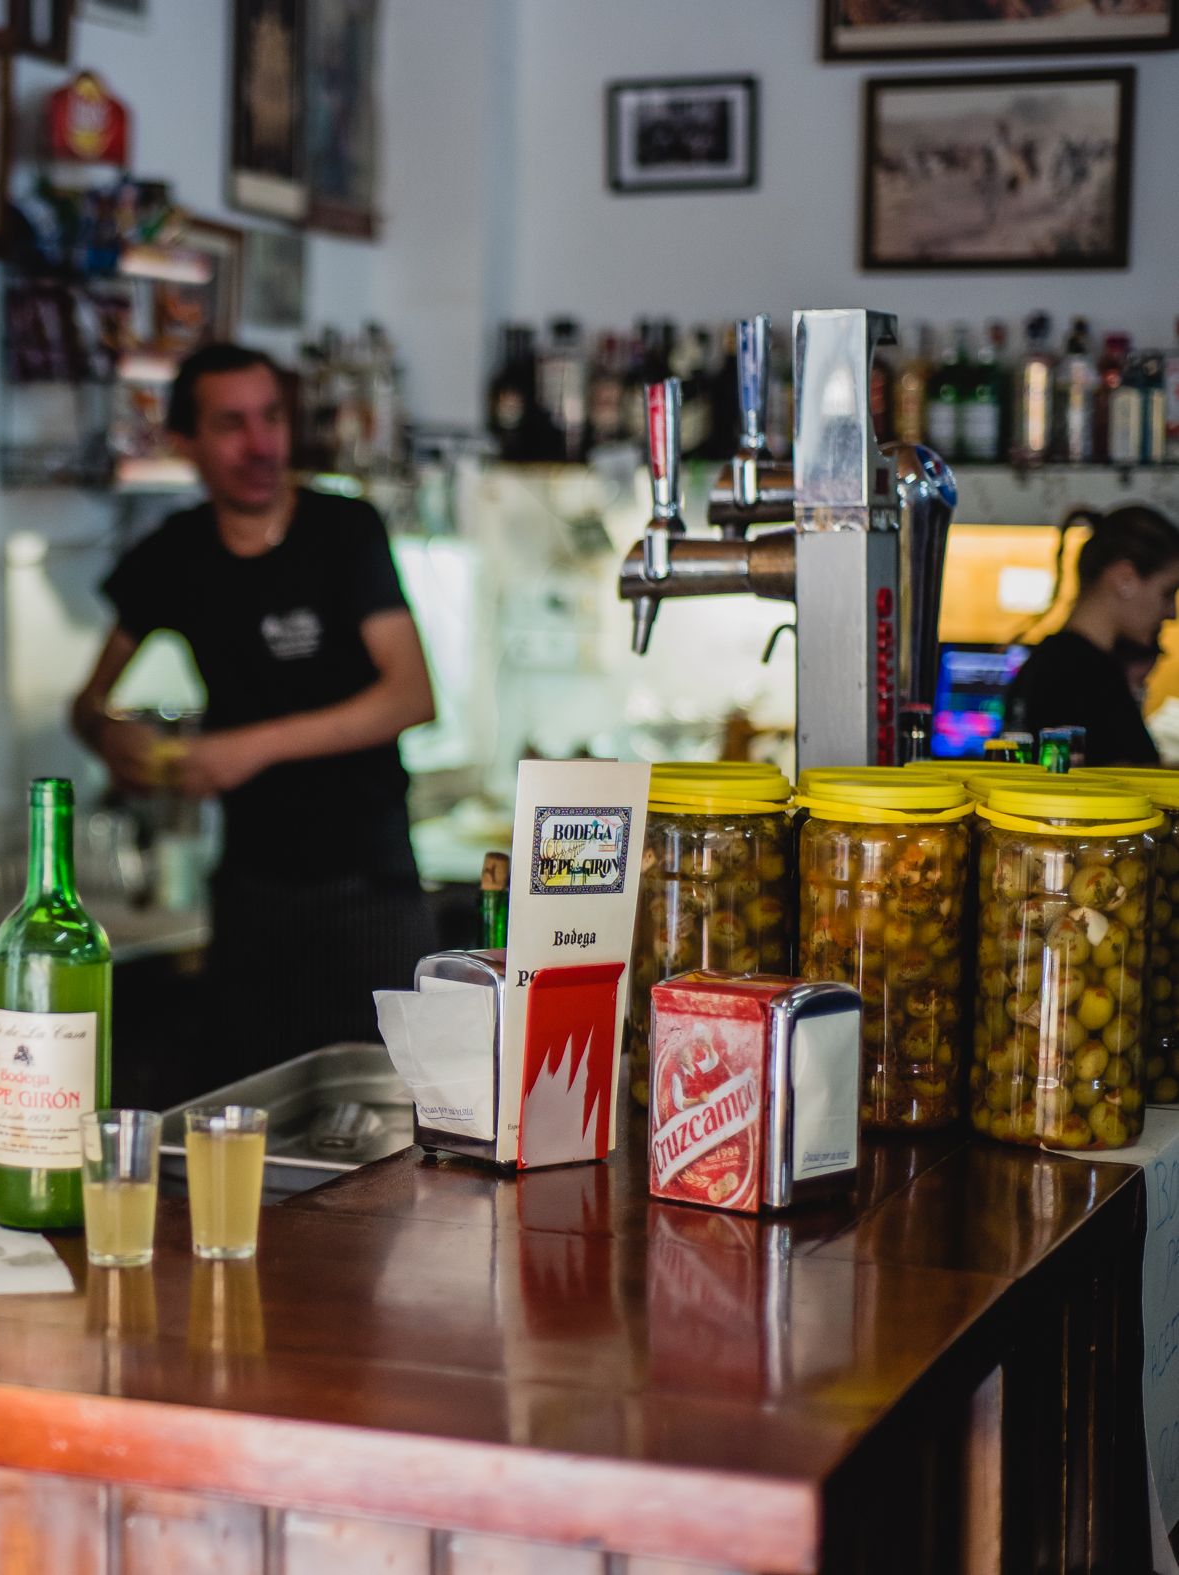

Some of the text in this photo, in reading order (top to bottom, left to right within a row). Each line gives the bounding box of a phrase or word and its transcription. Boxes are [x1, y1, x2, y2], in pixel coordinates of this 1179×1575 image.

[553, 824, 613, 841] BODEGA
[539, 859, 575, 876] PEPE
[552, 928, 596, 948] Bodega
[19, 1087, 80, 1109] GIRÓN
[653, 1080, 758, 1175] Cruzcampo
